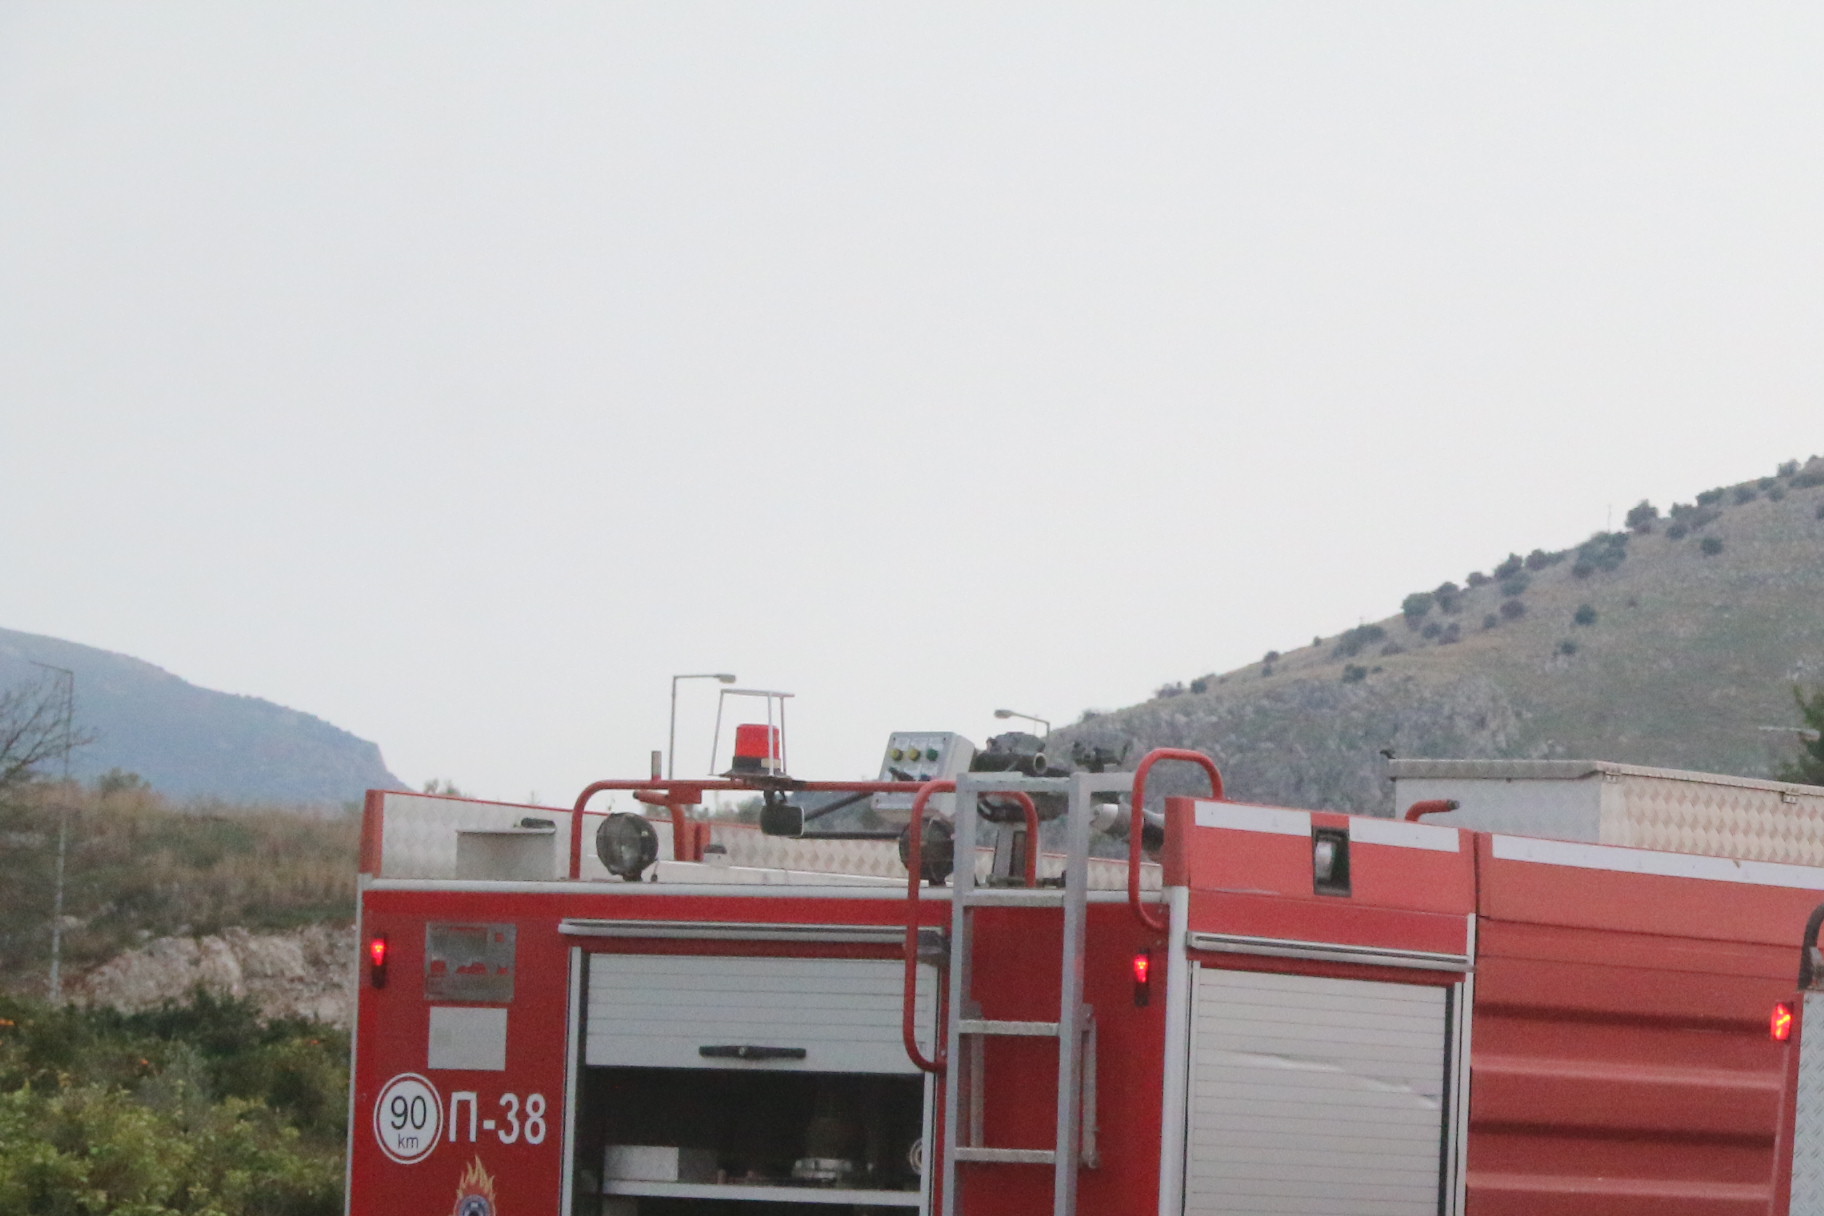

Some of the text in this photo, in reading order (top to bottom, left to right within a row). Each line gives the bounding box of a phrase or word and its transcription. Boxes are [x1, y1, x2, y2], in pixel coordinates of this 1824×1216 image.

[391, 1095, 427, 1130] 90
[449, 1091, 547, 1145] Π-38
[397, 1134, 419, 1149] km
